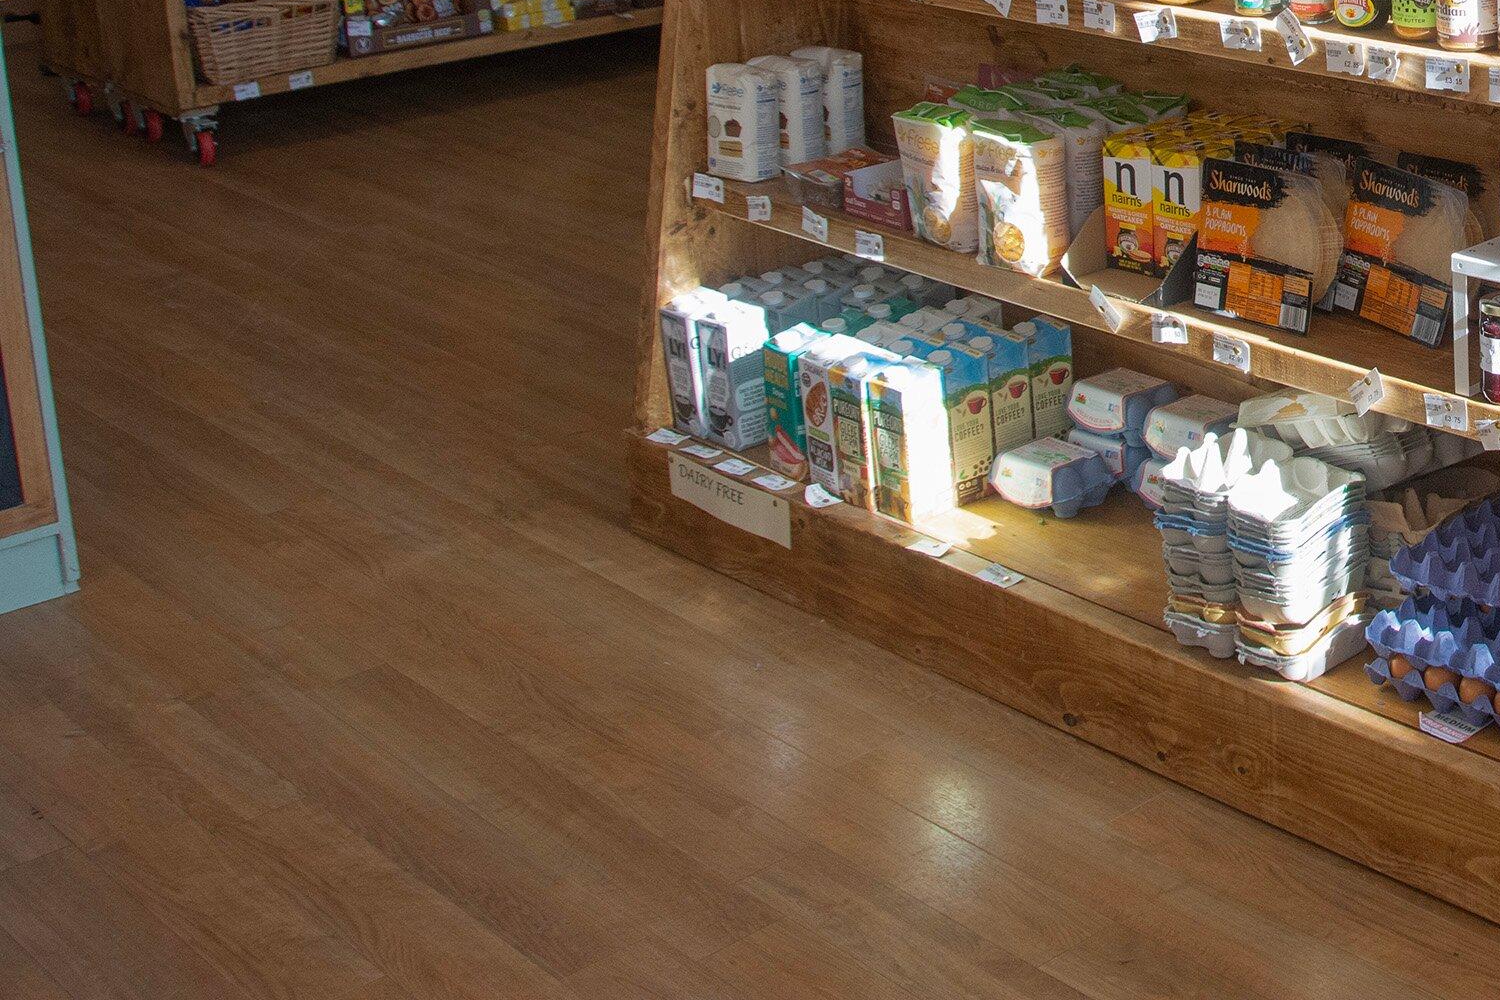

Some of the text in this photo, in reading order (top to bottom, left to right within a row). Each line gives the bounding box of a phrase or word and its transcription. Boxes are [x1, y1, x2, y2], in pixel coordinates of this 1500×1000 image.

[1115, 161, 1137, 196] n
[1210, 169, 1273, 201] Sharwood's
[1164, 170, 1185, 205] n
[1359, 169, 1421, 208] Sharwood's
[1112, 193, 1143, 208] nairn's
[1160, 202, 1191, 217] nairn's
[1213, 207, 1233, 220] PLAIN
[1360, 208, 1378, 223] PLAIN
[1112, 214, 1144, 225] OATCAKES
[1205, 219, 1246, 237] POPPADOMS
[1351, 217, 1391, 241] POPPADOMS
[996, 410, 1025, 426] COFFEE?
[954, 427, 985, 442] COFFEE?
[678, 463, 745, 506] DAIRY FREE
